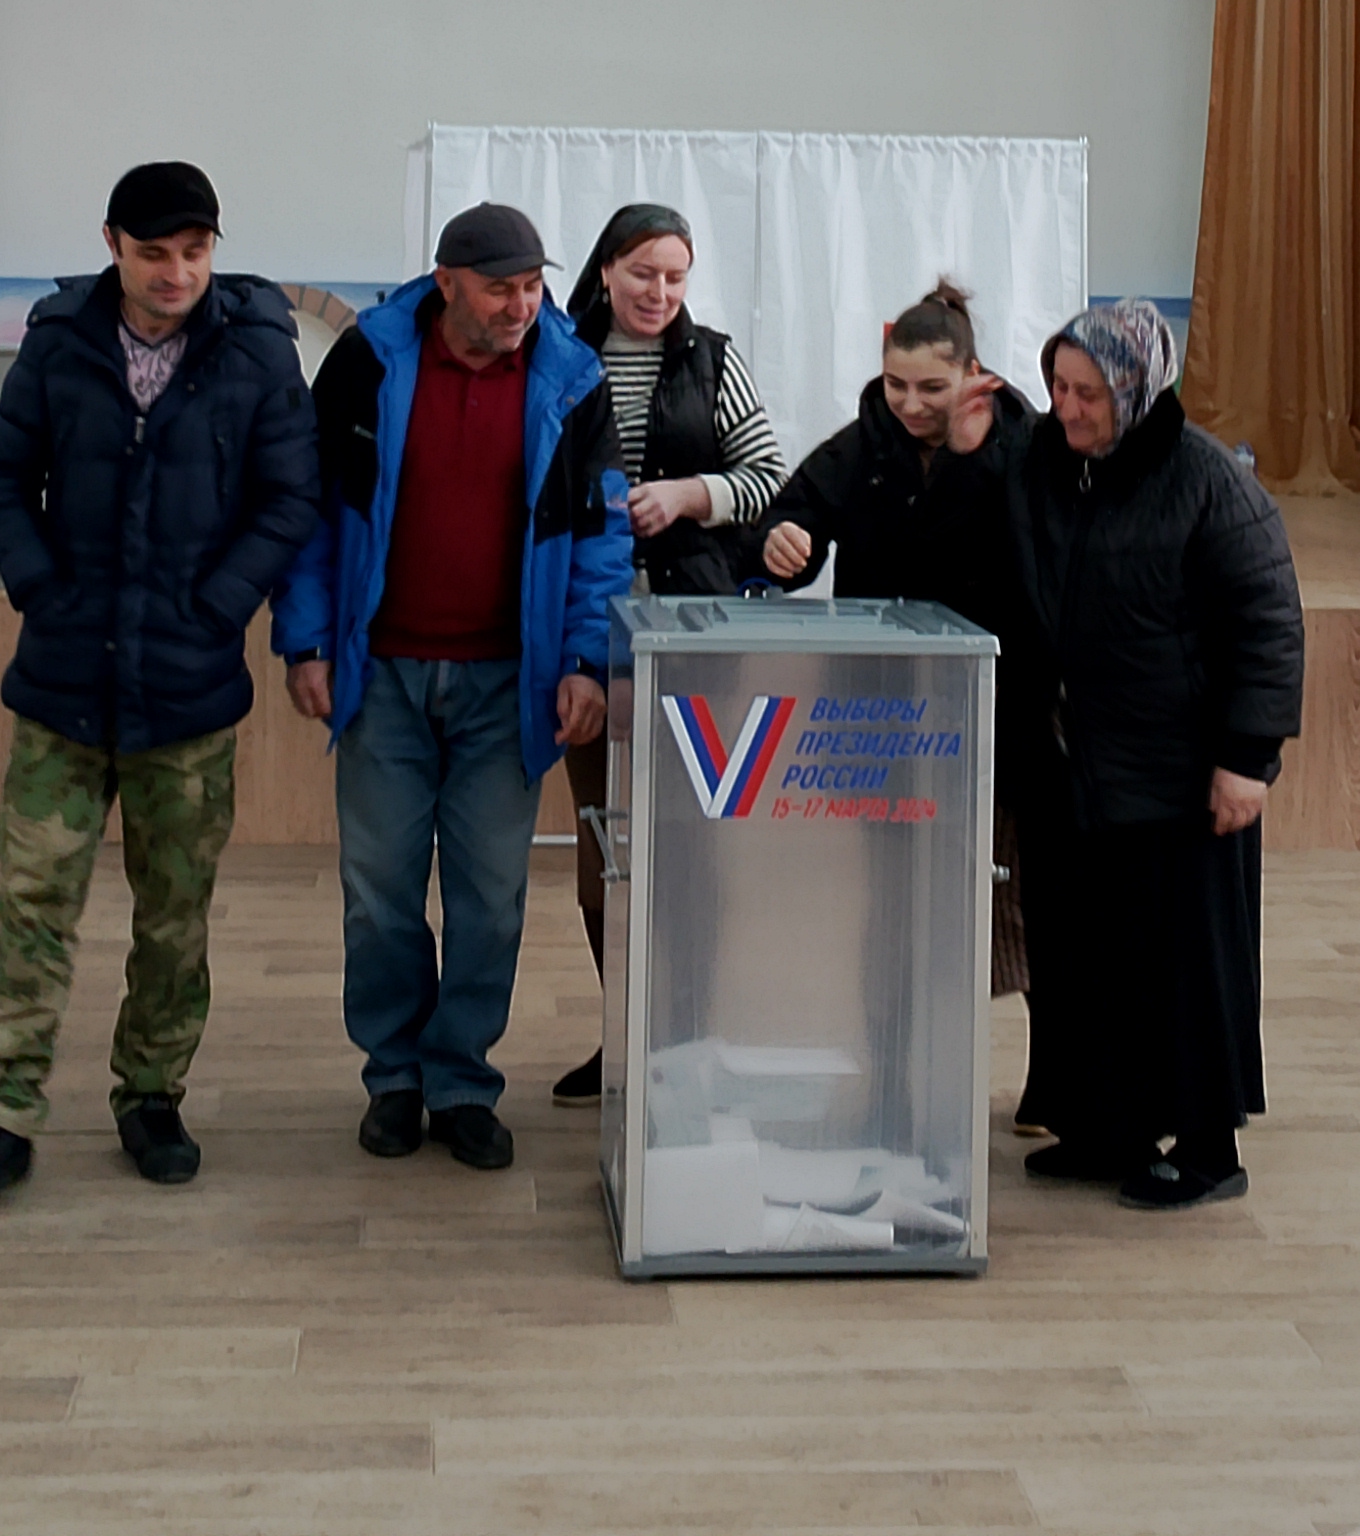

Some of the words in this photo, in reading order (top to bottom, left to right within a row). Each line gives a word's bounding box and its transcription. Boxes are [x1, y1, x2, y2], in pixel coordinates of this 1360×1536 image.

[809, 696, 928, 723] ВЫБОРЫ
[794, 730, 962, 759] ПРЕЗИДЕНТА
[780, 764, 889, 790] РОССИИ
[824, 797, 889, 822] МАРТА
[889, 797, 938, 823] 2024
